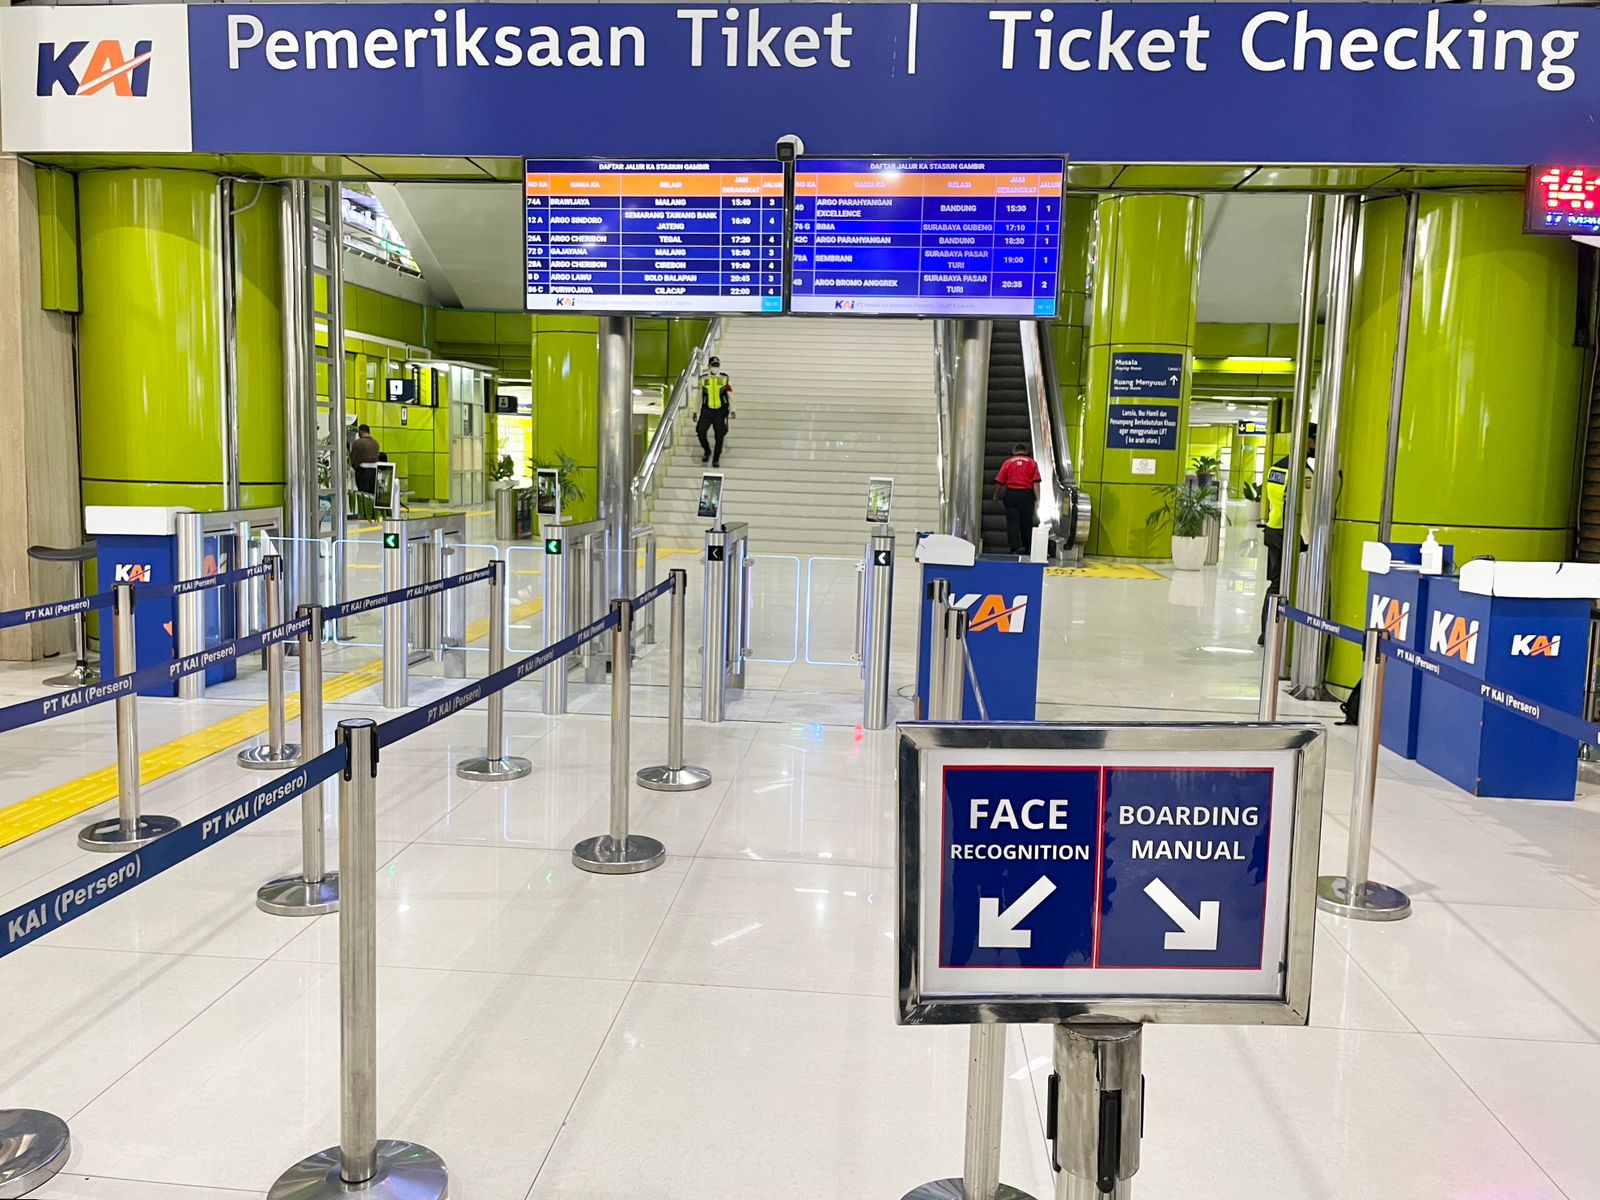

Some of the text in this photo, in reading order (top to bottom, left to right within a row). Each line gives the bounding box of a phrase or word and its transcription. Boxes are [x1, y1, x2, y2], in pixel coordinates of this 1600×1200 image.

[228, 9, 851, 70] Pemeriksaan Tiket
[989, 8, 1579, 92] Ticket Checking
[36, 41, 152, 97] KAI
[644, 274, 663, 282] SOLO
[115, 564, 151, 582] KAI
[25, 599, 90, 620] PT KAI (Persero)
[351, 600, 361, 611] KAI
[1370, 594, 1410, 641] KAI
[262, 626, 284, 644] PT KAI
[1430, 610, 1479, 664] KAI
[1511, 635, 1560, 656] KAI
[170, 643, 236, 676] PT KAI (Persero)
[1405, 652, 1414, 663] KAI
[43, 675, 133, 714] PT KAI (Persero)
[1481, 685, 1539, 719] PT KAI (Persero)
[202, 769, 307, 840] PT KAI (Persero)
[970, 799, 1068, 830] FACE
[1119, 805, 1259, 826] BOARDING
[951, 844, 1089, 861] RECOGNITION
[1132, 840, 1245, 861] MANUAL
[8, 853, 140, 942] KAI (Persero)
